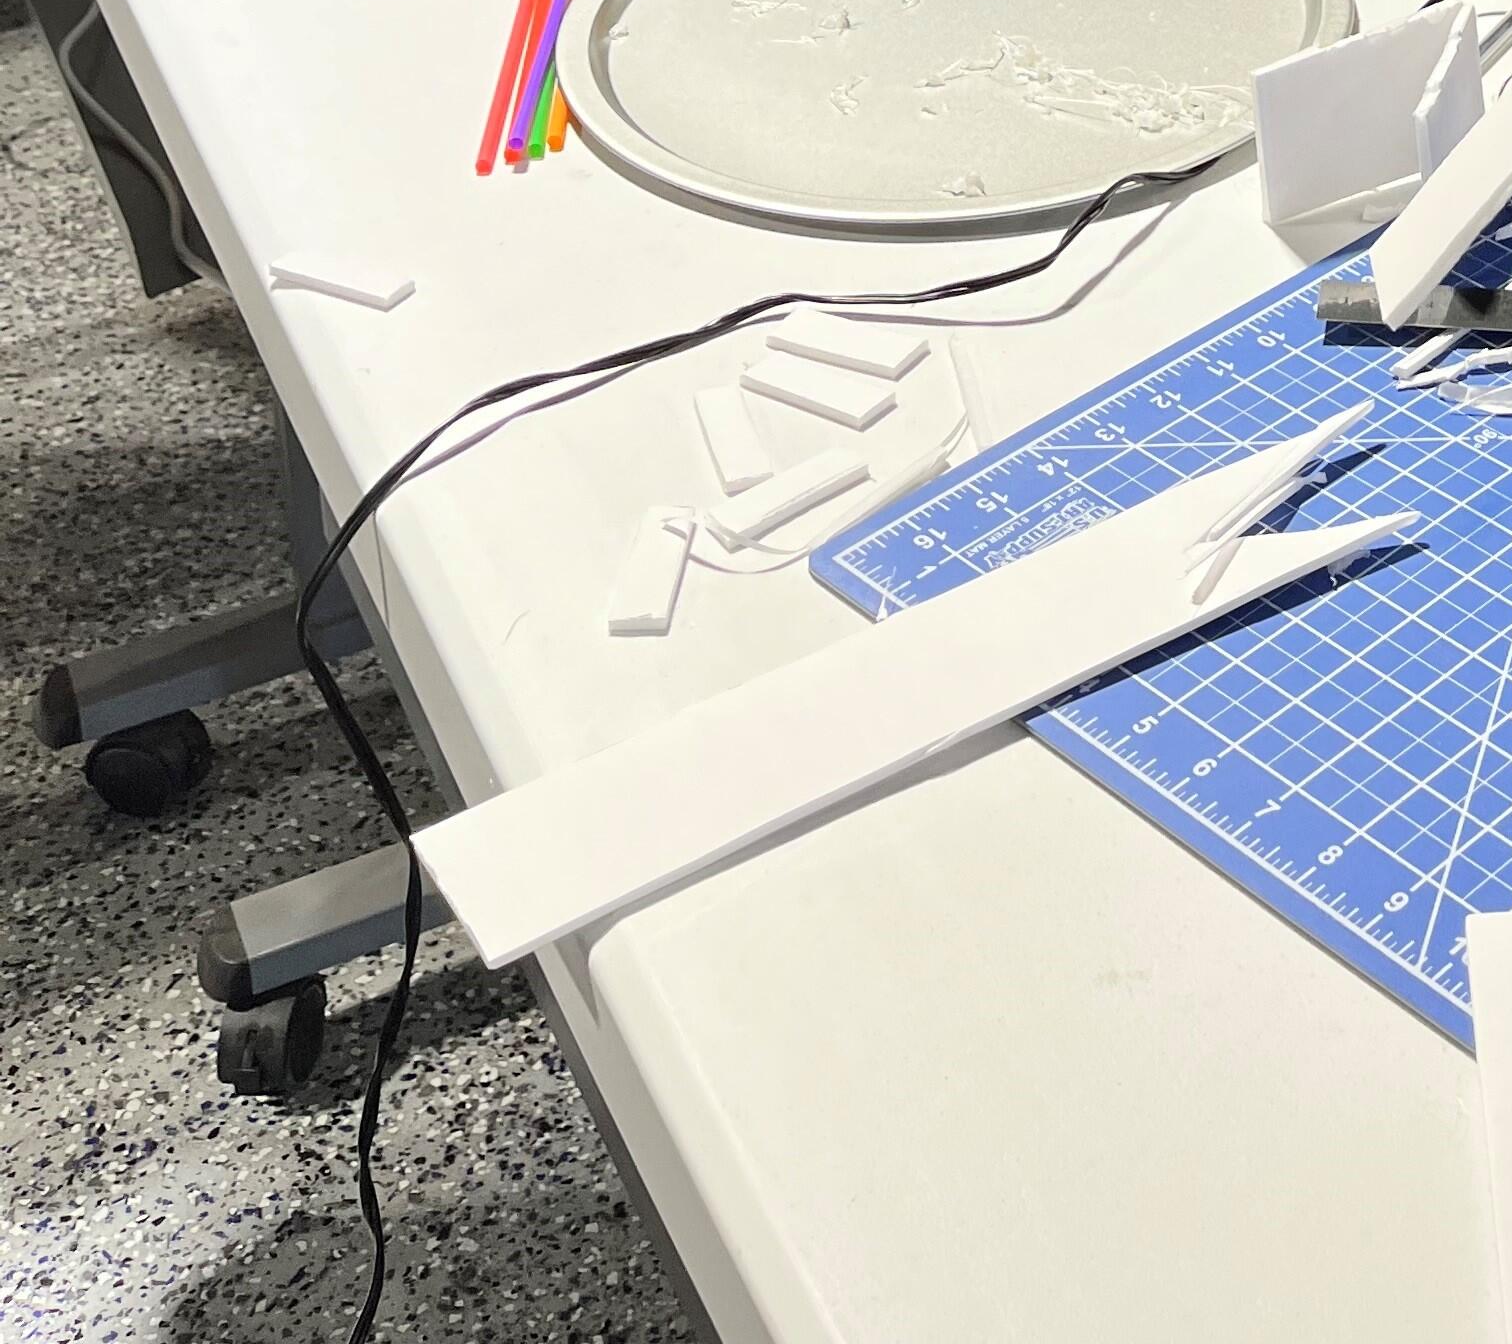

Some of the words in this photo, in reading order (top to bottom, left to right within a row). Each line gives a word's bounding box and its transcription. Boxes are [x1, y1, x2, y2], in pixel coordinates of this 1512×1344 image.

[1256, 329, 1286, 348] 10
[1206, 359, 1235, 377] 11
[1149, 390, 1182, 409] 12
[1094, 422, 1126, 442] 13
[1037, 456, 1069, 476] 14
[975, 491, 1009, 512] 15
[912, 527, 948, 550] 16
[965, 543, 989, 558] MAT
[1132, 715, 1160, 736] 5
[1192, 757, 1218, 777] 6
[1254, 799, 1282, 819] 7
[1317, 845, 1344, 865] 8
[1383, 892, 1409, 912] 9
